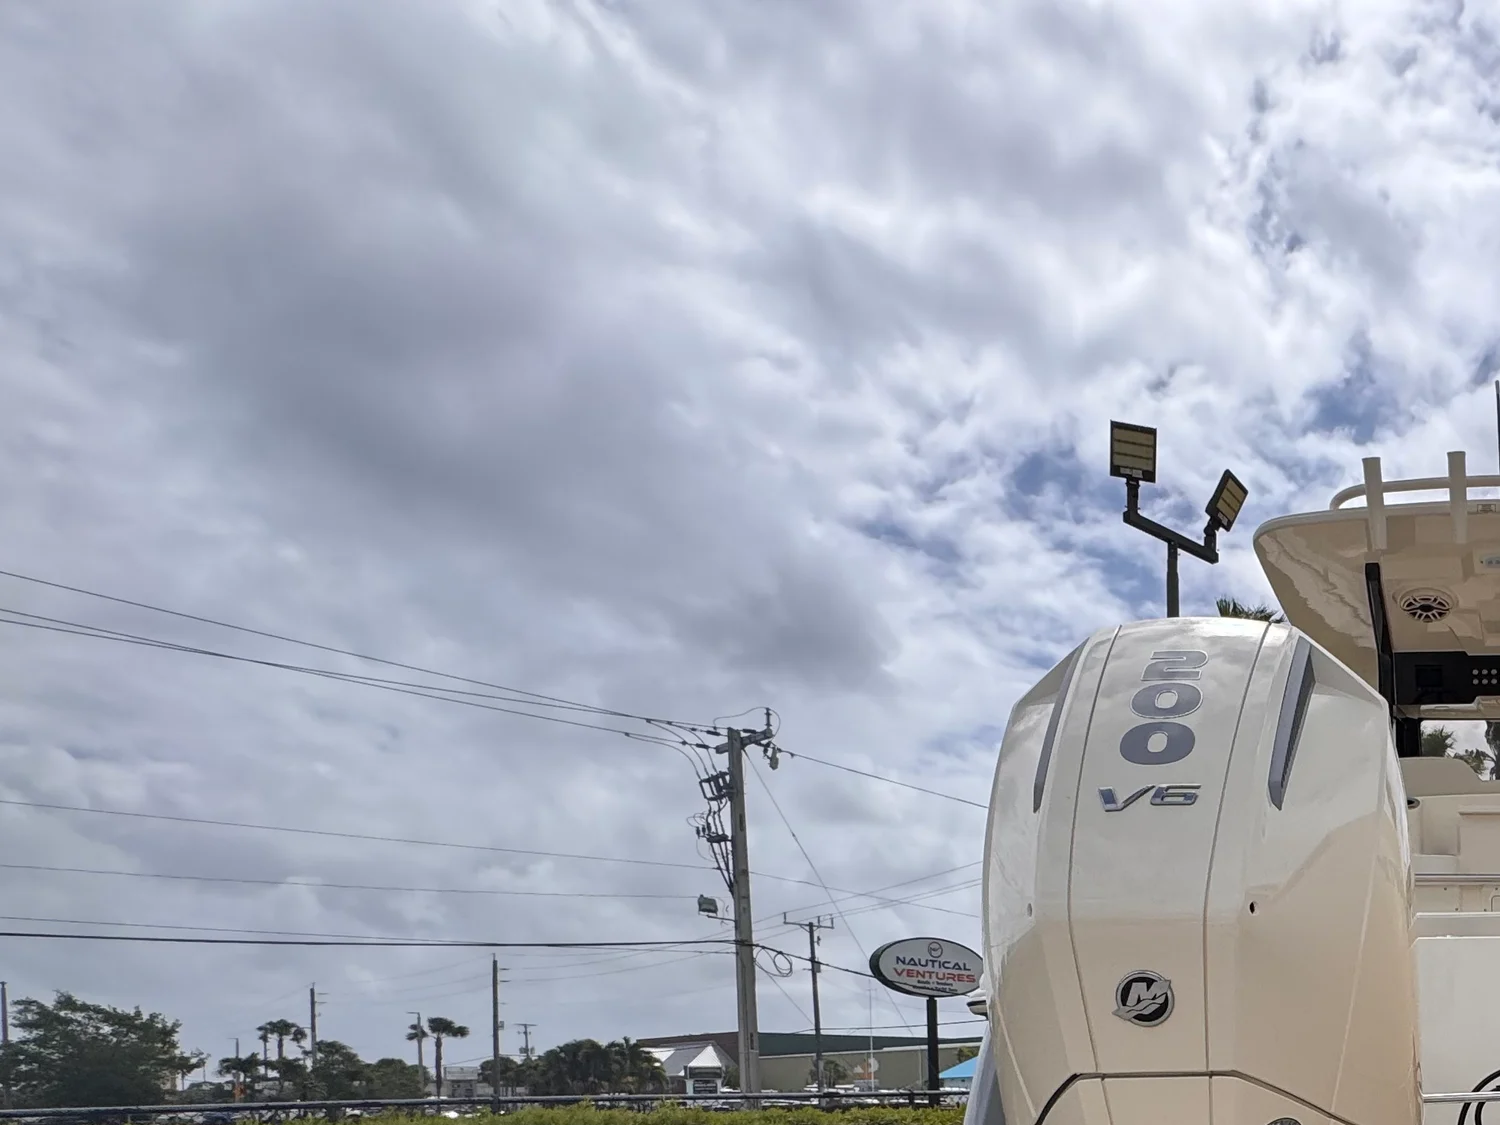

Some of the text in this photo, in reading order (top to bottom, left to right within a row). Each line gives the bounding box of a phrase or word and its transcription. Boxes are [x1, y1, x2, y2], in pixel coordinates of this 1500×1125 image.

[1119, 649, 1209, 766] 200
[1098, 783, 1202, 812] V6
[896, 956, 972, 971] NAUTICAL
[893, 967, 977, 983] VENTURES
